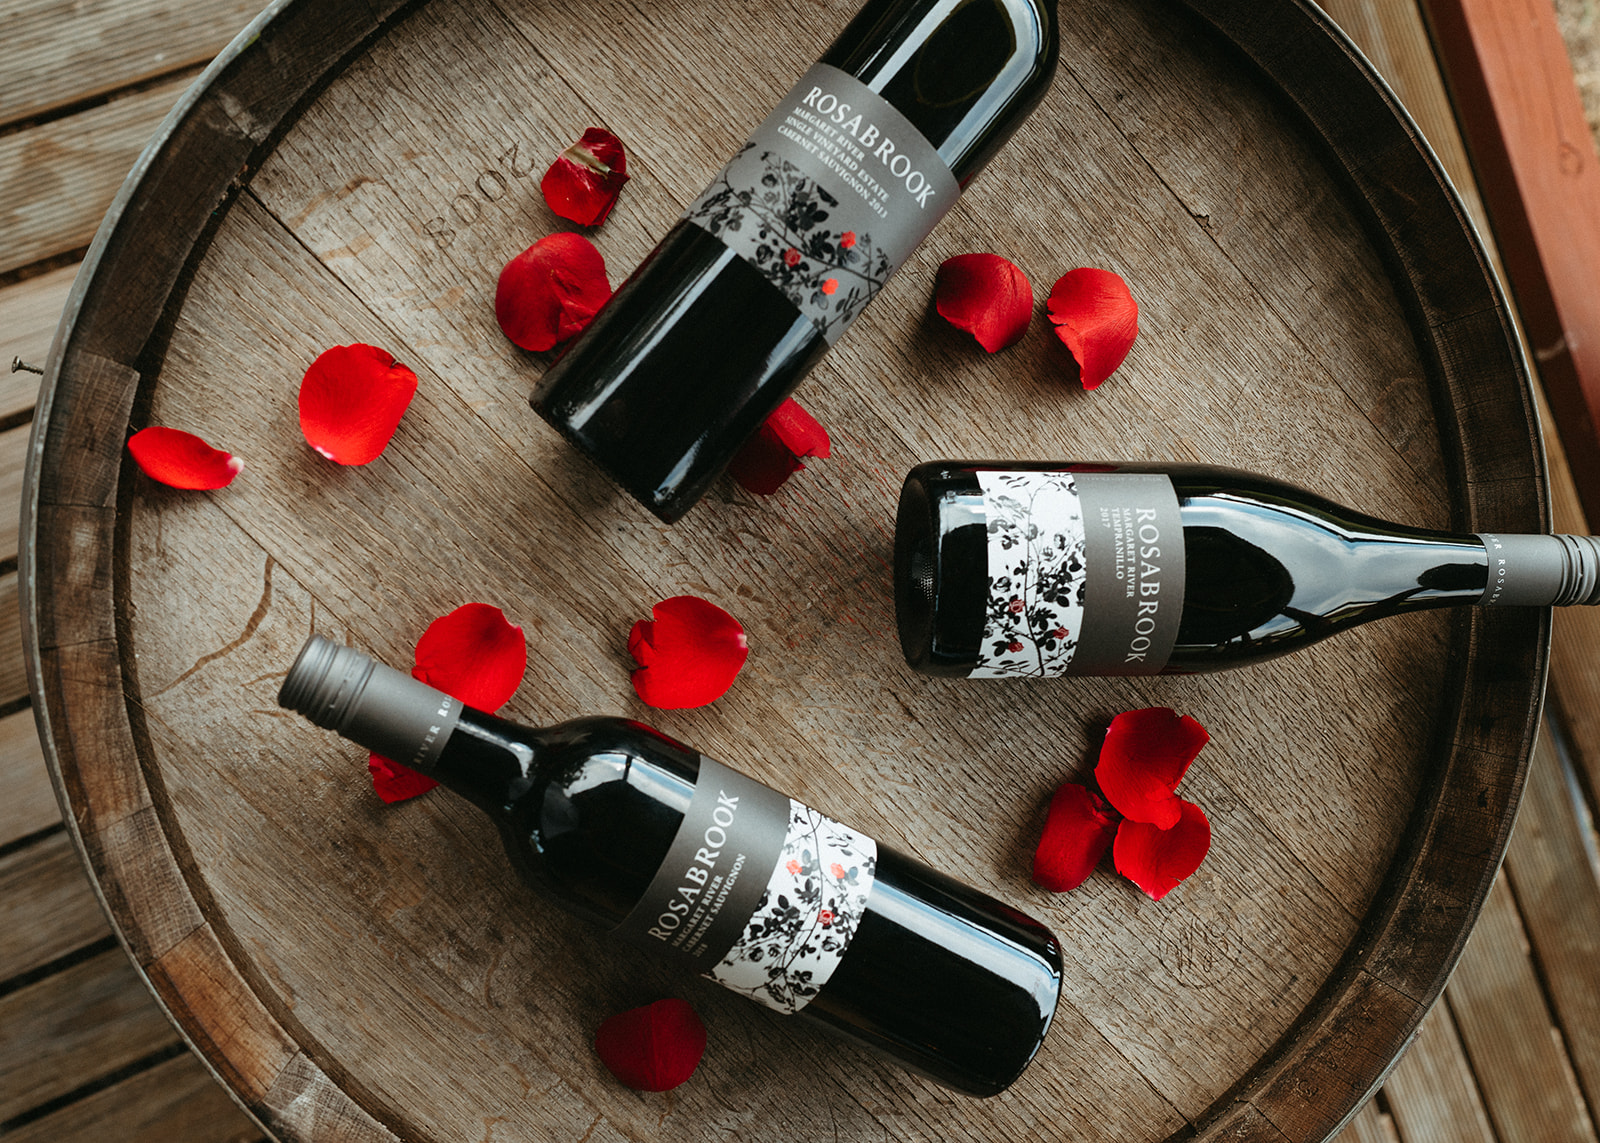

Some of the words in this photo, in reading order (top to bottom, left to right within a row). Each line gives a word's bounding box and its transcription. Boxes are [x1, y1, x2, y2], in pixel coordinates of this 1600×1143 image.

[777, 125, 819, 154] CABERNET
[817, 151, 871, 200] SAUVIGNON
[868, 199, 888, 219] 2013
[785, 115, 813, 136] SINGLE
[813, 131, 858, 171] VINEYARD
[857, 169, 890, 203] ESTATE
[792, 106, 838, 138] MARGARET
[836, 134, 866, 162] RIVER
[802, 86, 935, 209] ROSABROOK
[423, 140, 535, 249] 2008
[1100, 507, 1111, 529] 2017
[1111, 507, 1125, 580] TEMPRANILLO
[1122, 507, 1136, 564] MARGARET
[1125, 508, 1161, 663] ROSABROOK
[1126, 566, 1136, 598] RIVER
[648, 789, 739, 941] ROSABROOK
[682, 916, 714, 952] CABERNET
[711, 853, 746, 915] SAUVIGNON
[672, 907, 705, 947] MARGARET
[701, 875, 724, 907] RIVER
